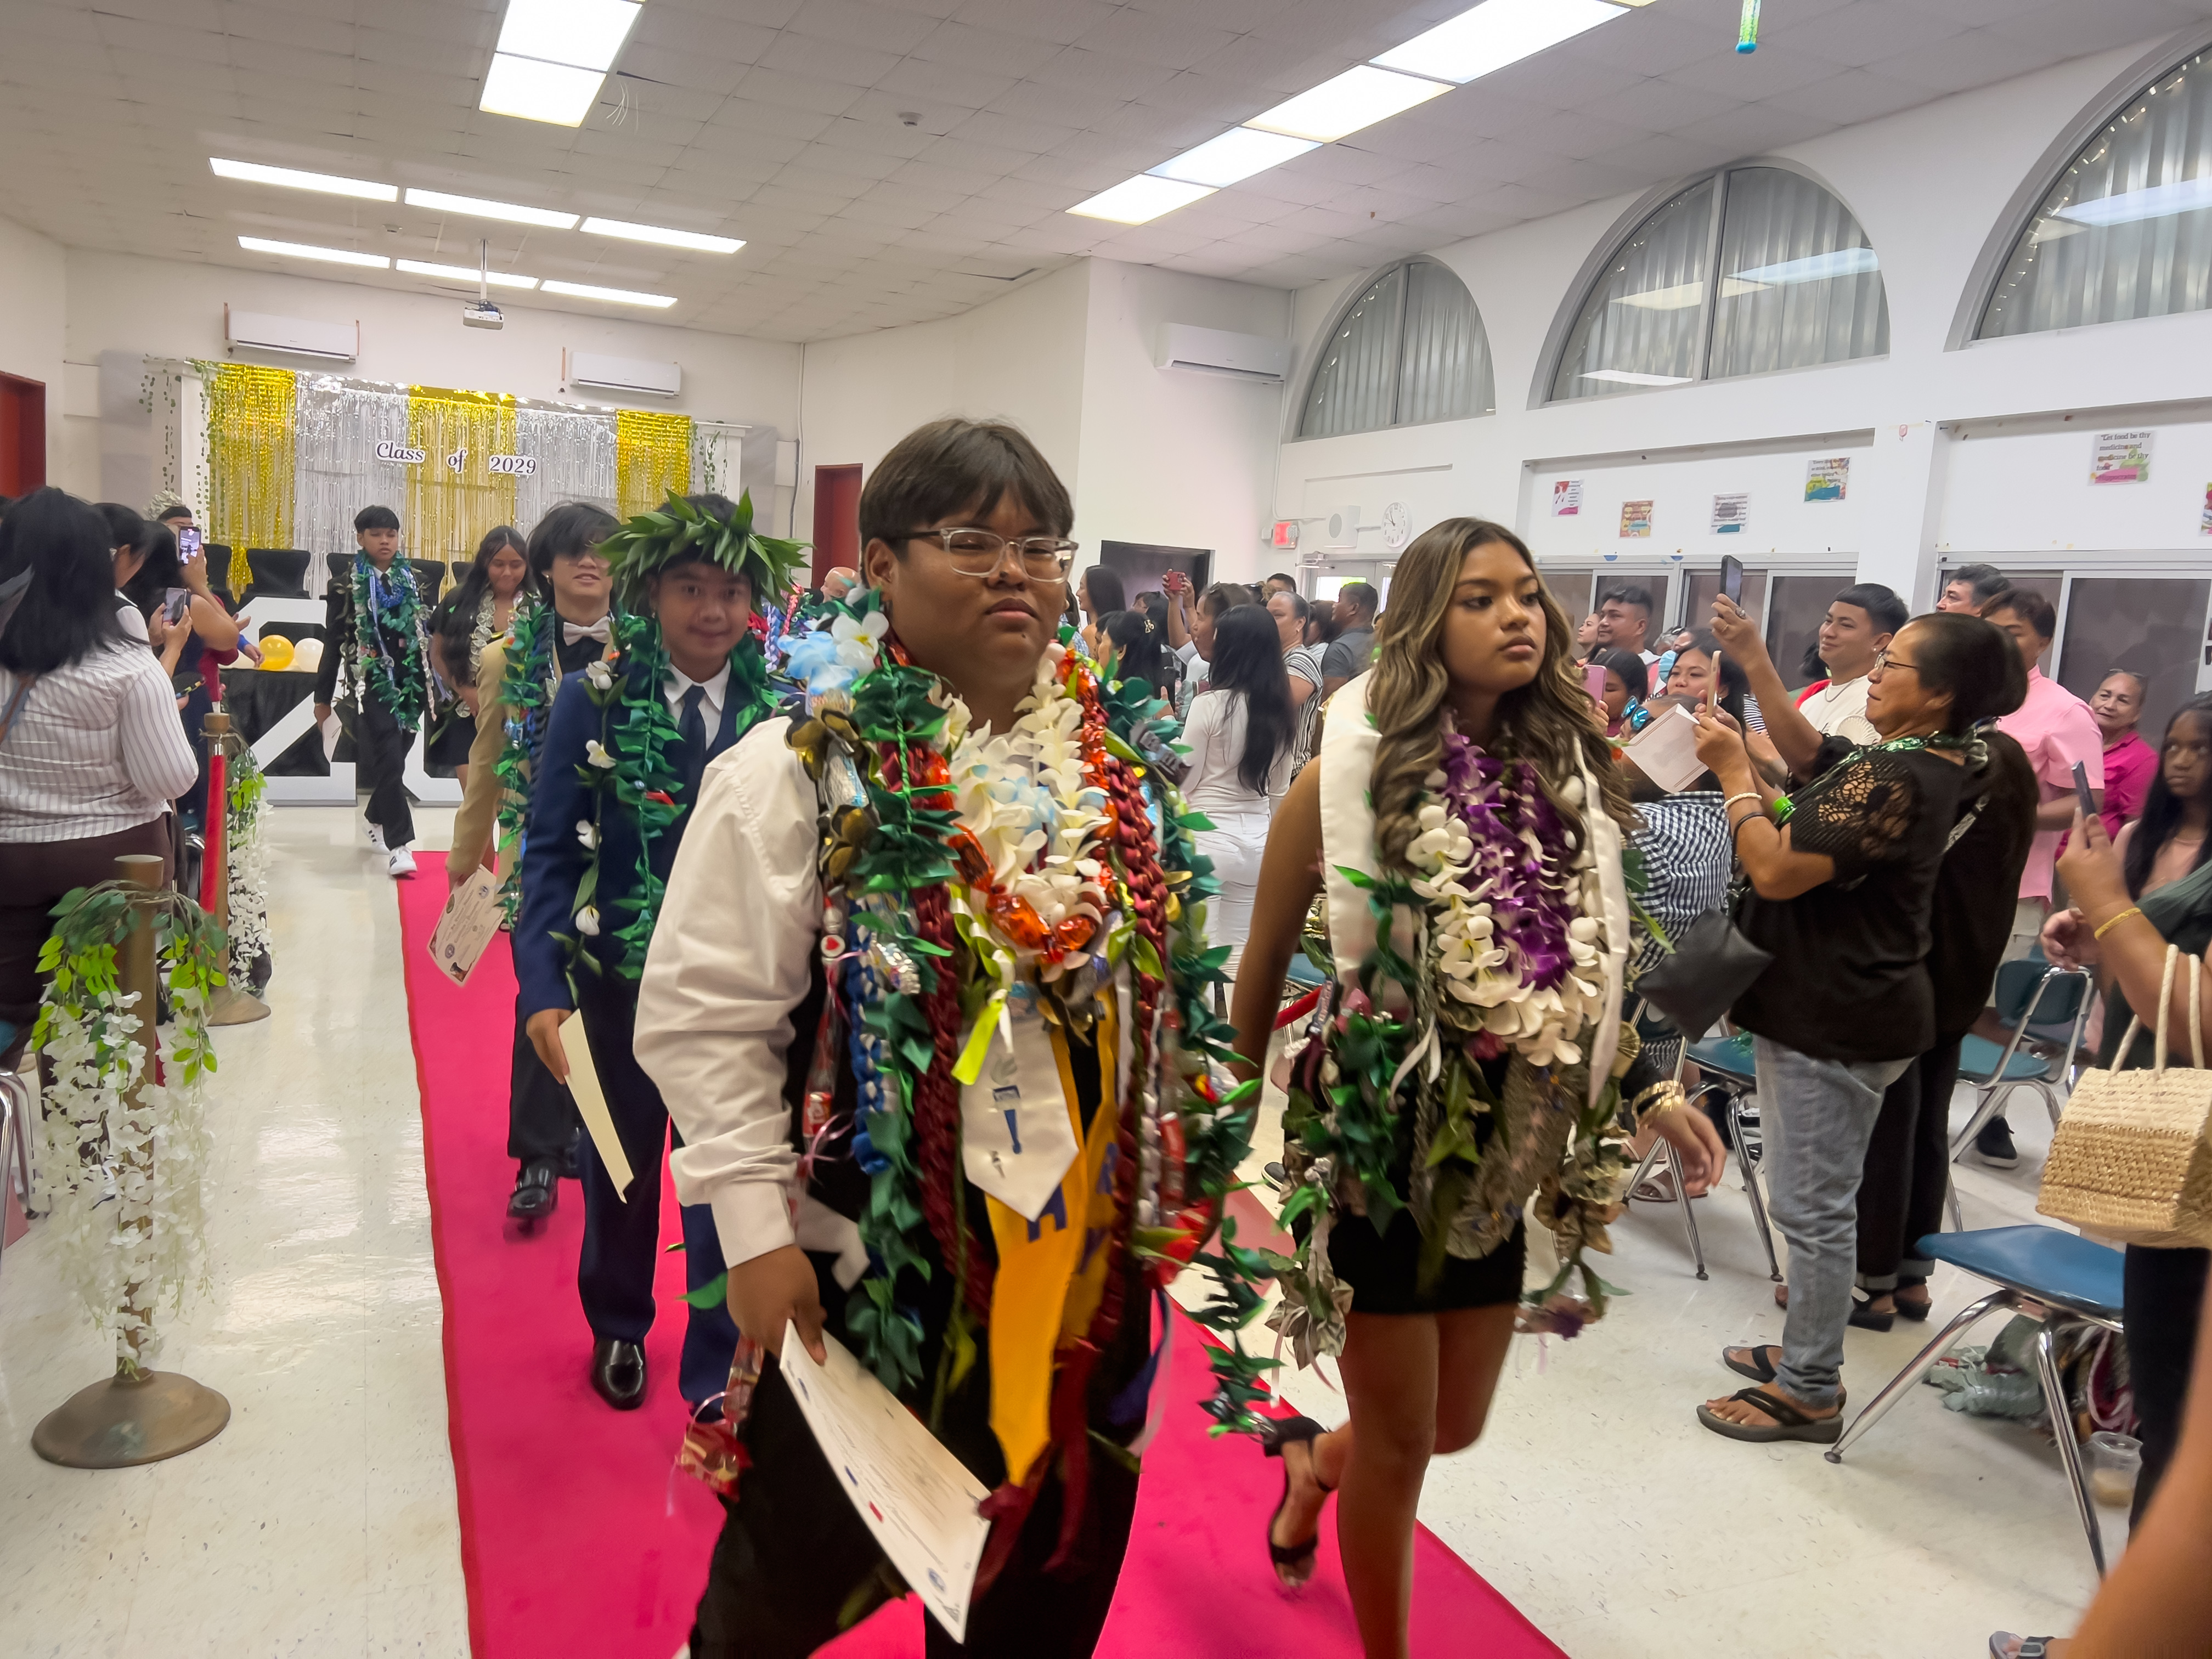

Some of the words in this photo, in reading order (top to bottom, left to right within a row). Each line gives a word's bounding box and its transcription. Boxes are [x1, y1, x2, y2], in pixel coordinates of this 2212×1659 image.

[376, 442, 424, 461] Class
[448, 449, 467, 472] of
[490, 456, 537, 474] 2029
